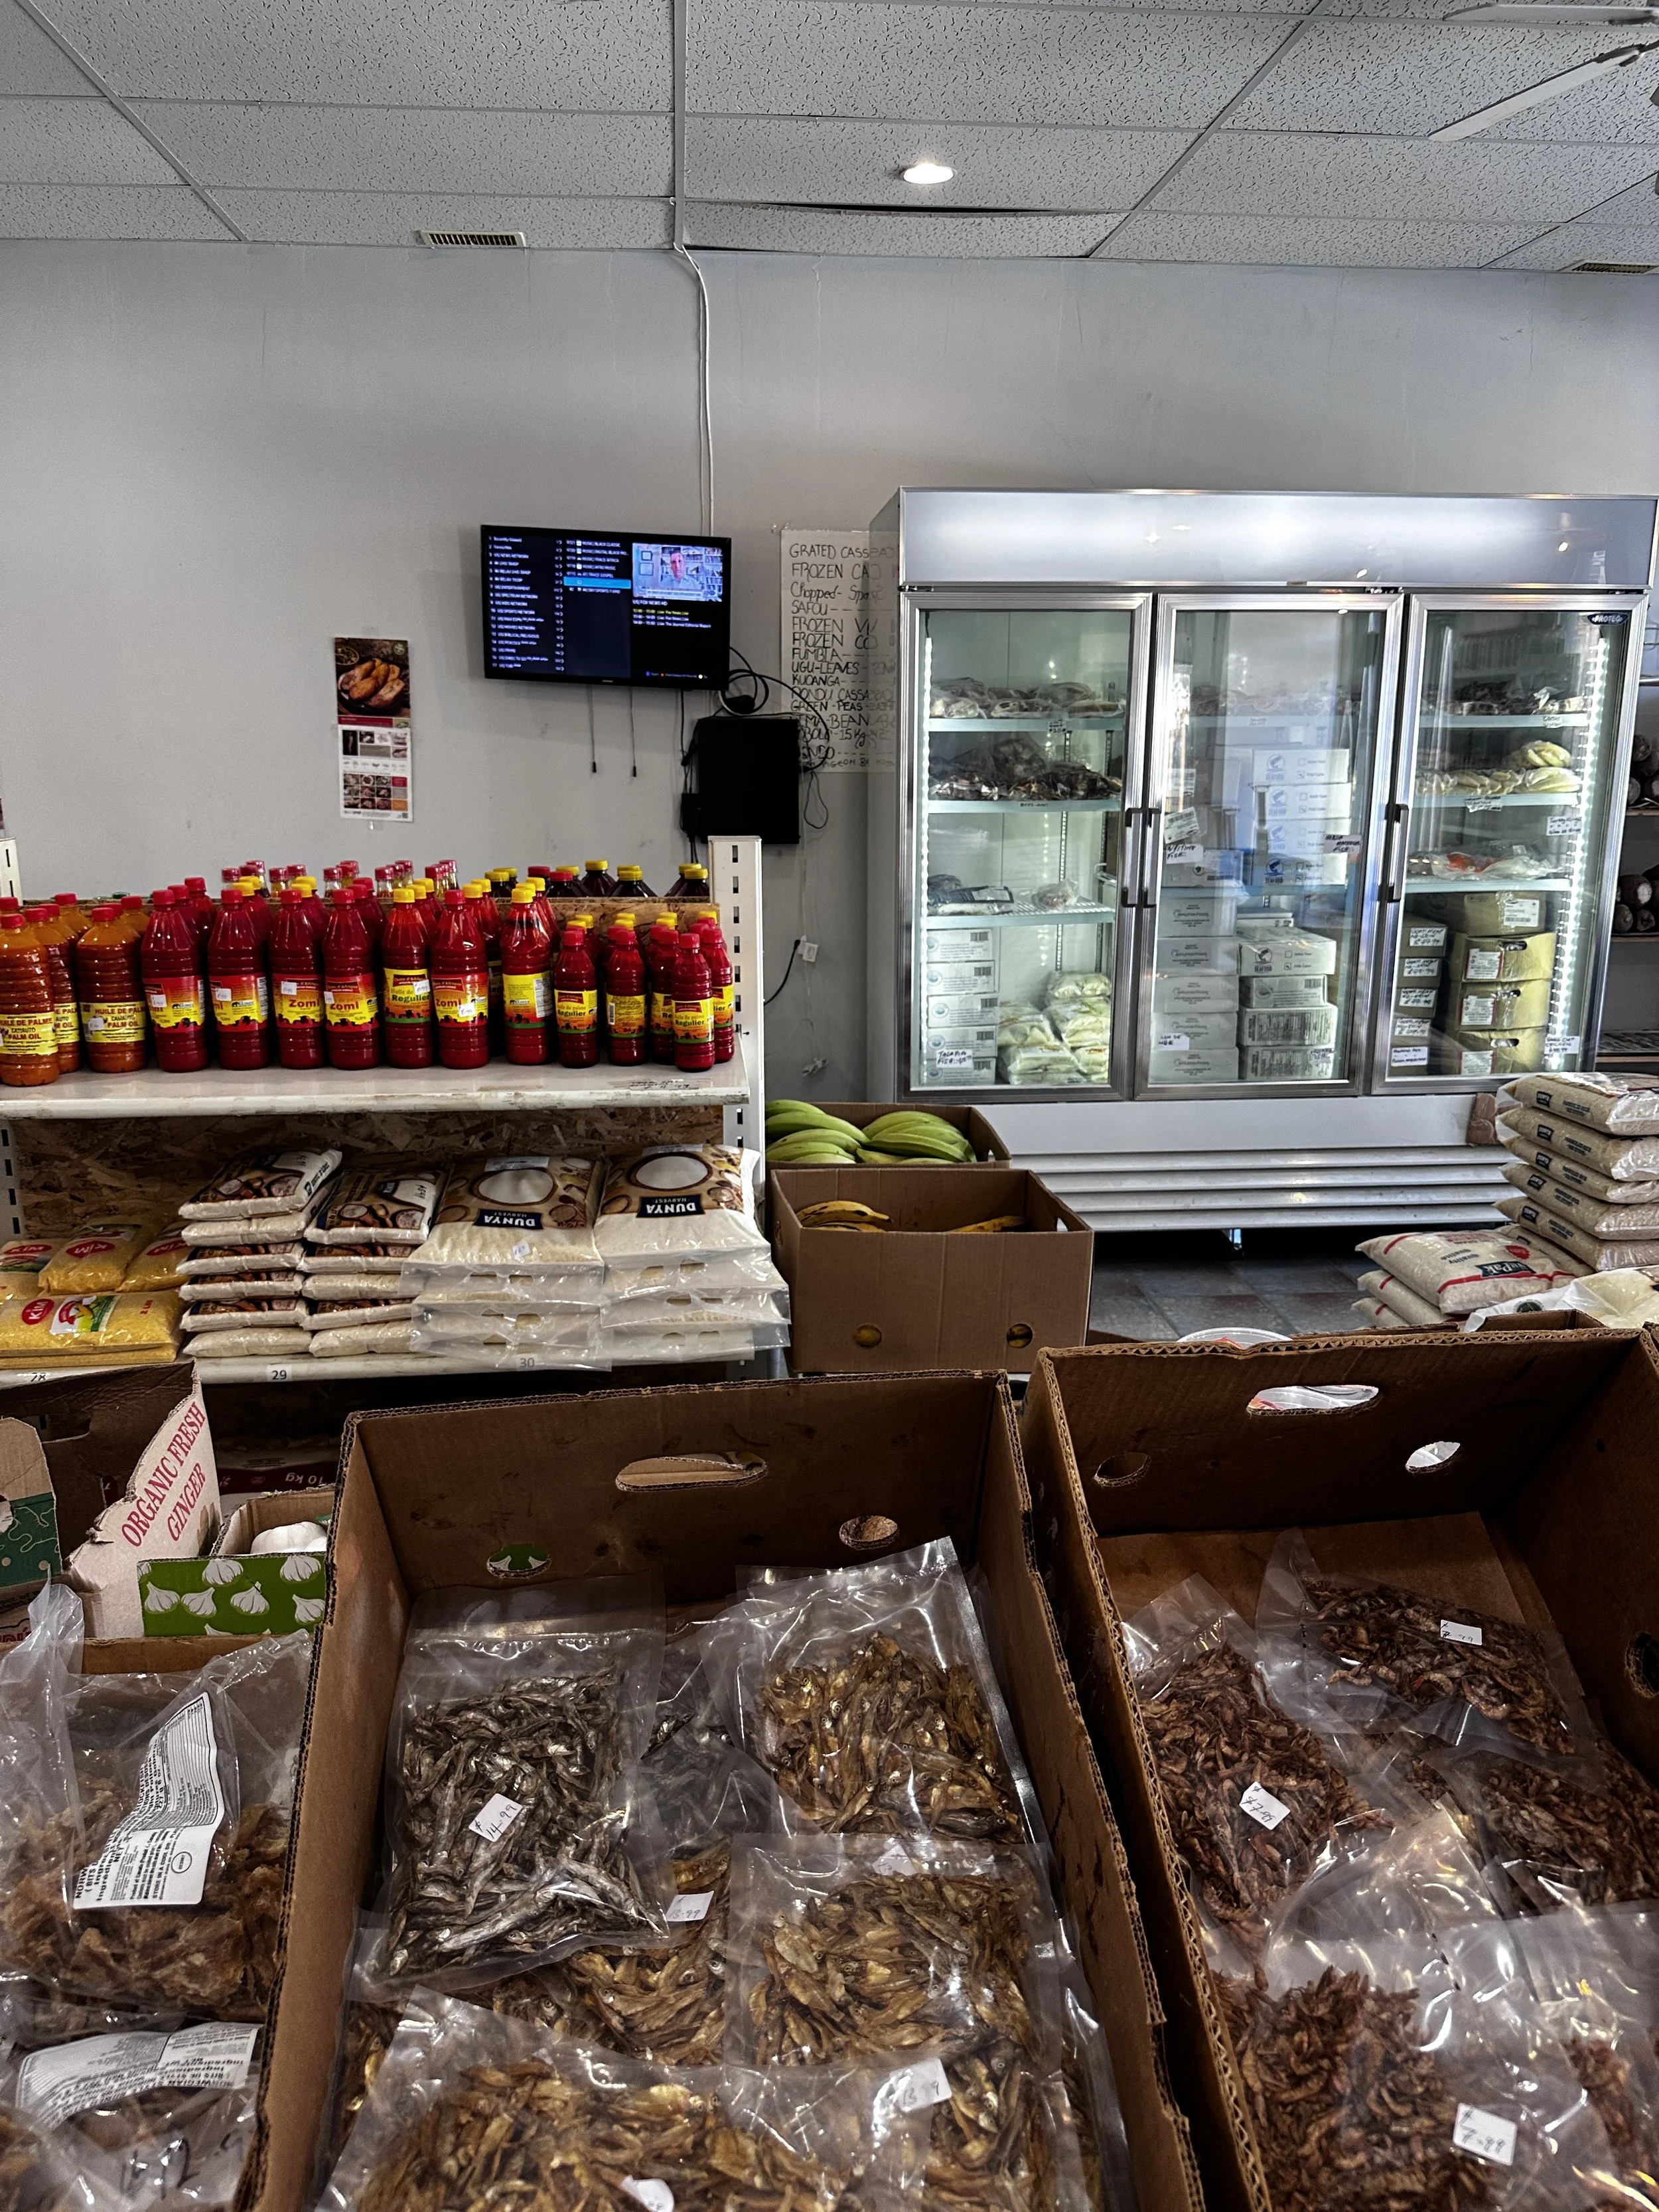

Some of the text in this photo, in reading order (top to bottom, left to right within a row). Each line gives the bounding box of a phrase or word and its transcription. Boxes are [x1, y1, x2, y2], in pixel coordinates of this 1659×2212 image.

[789, 544, 836, 559] GRATED
[792, 562, 843, 582] FROZEN
[792, 617, 843, 633] FROZEN
[792, 632, 843, 648] FROZEN
[289, 999, 320, 1008] Zomi
[28, 1017, 53, 1026] PALME
[646, 1203, 697, 1214] DUNYA
[484, 1216, 536, 1227] DUNYA
[29, 1300, 48, 1321] KIM
[520, 1357, 535, 1368] 30
[272, 1370, 287, 1380] 29
[121, 1402, 207, 1548] ORGANIC FRESH
[166, 1463, 206, 1542] GINGER
